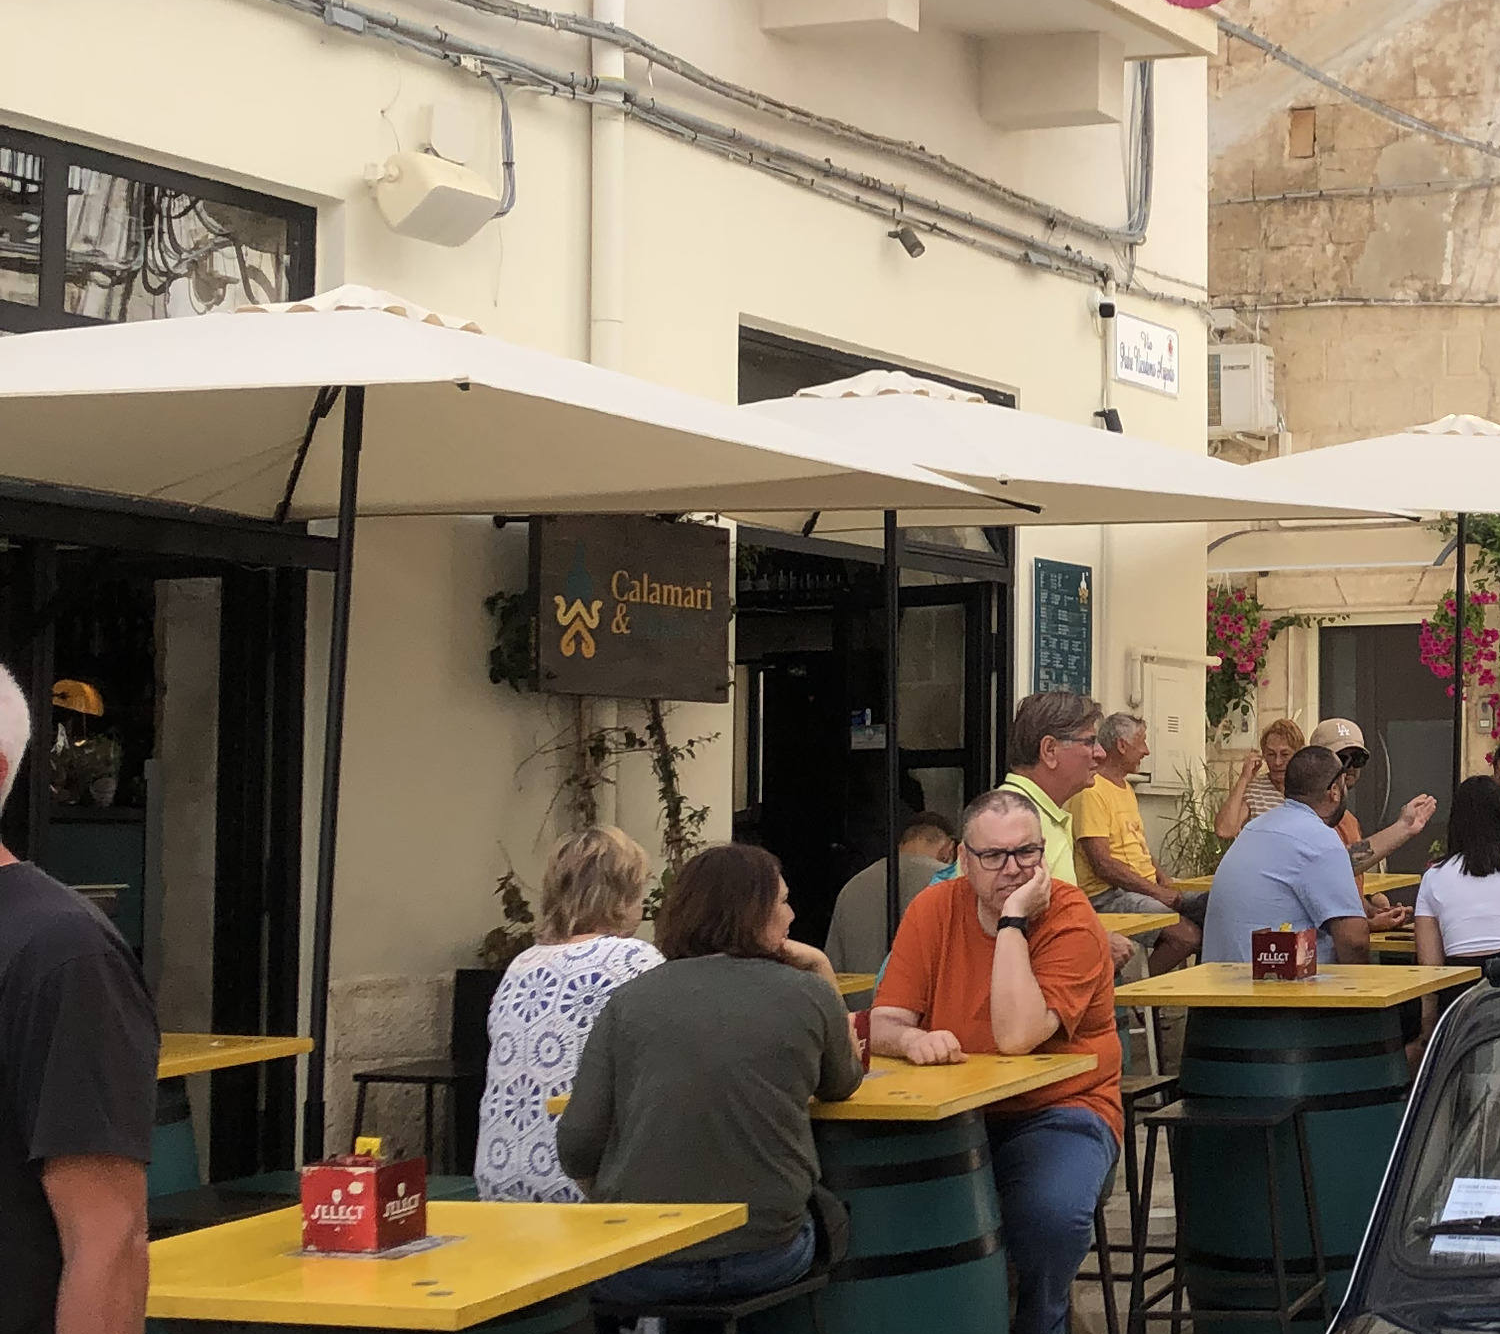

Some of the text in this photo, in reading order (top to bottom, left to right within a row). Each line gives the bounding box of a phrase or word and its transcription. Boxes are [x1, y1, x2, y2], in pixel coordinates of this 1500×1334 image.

[612, 570, 712, 610] Calamari
[610, 602, 632, 635] &
[1336, 723, 1350, 736] LA
[1256, 952, 1290, 962] SELECT
[310, 1204, 366, 1220] SELECT
